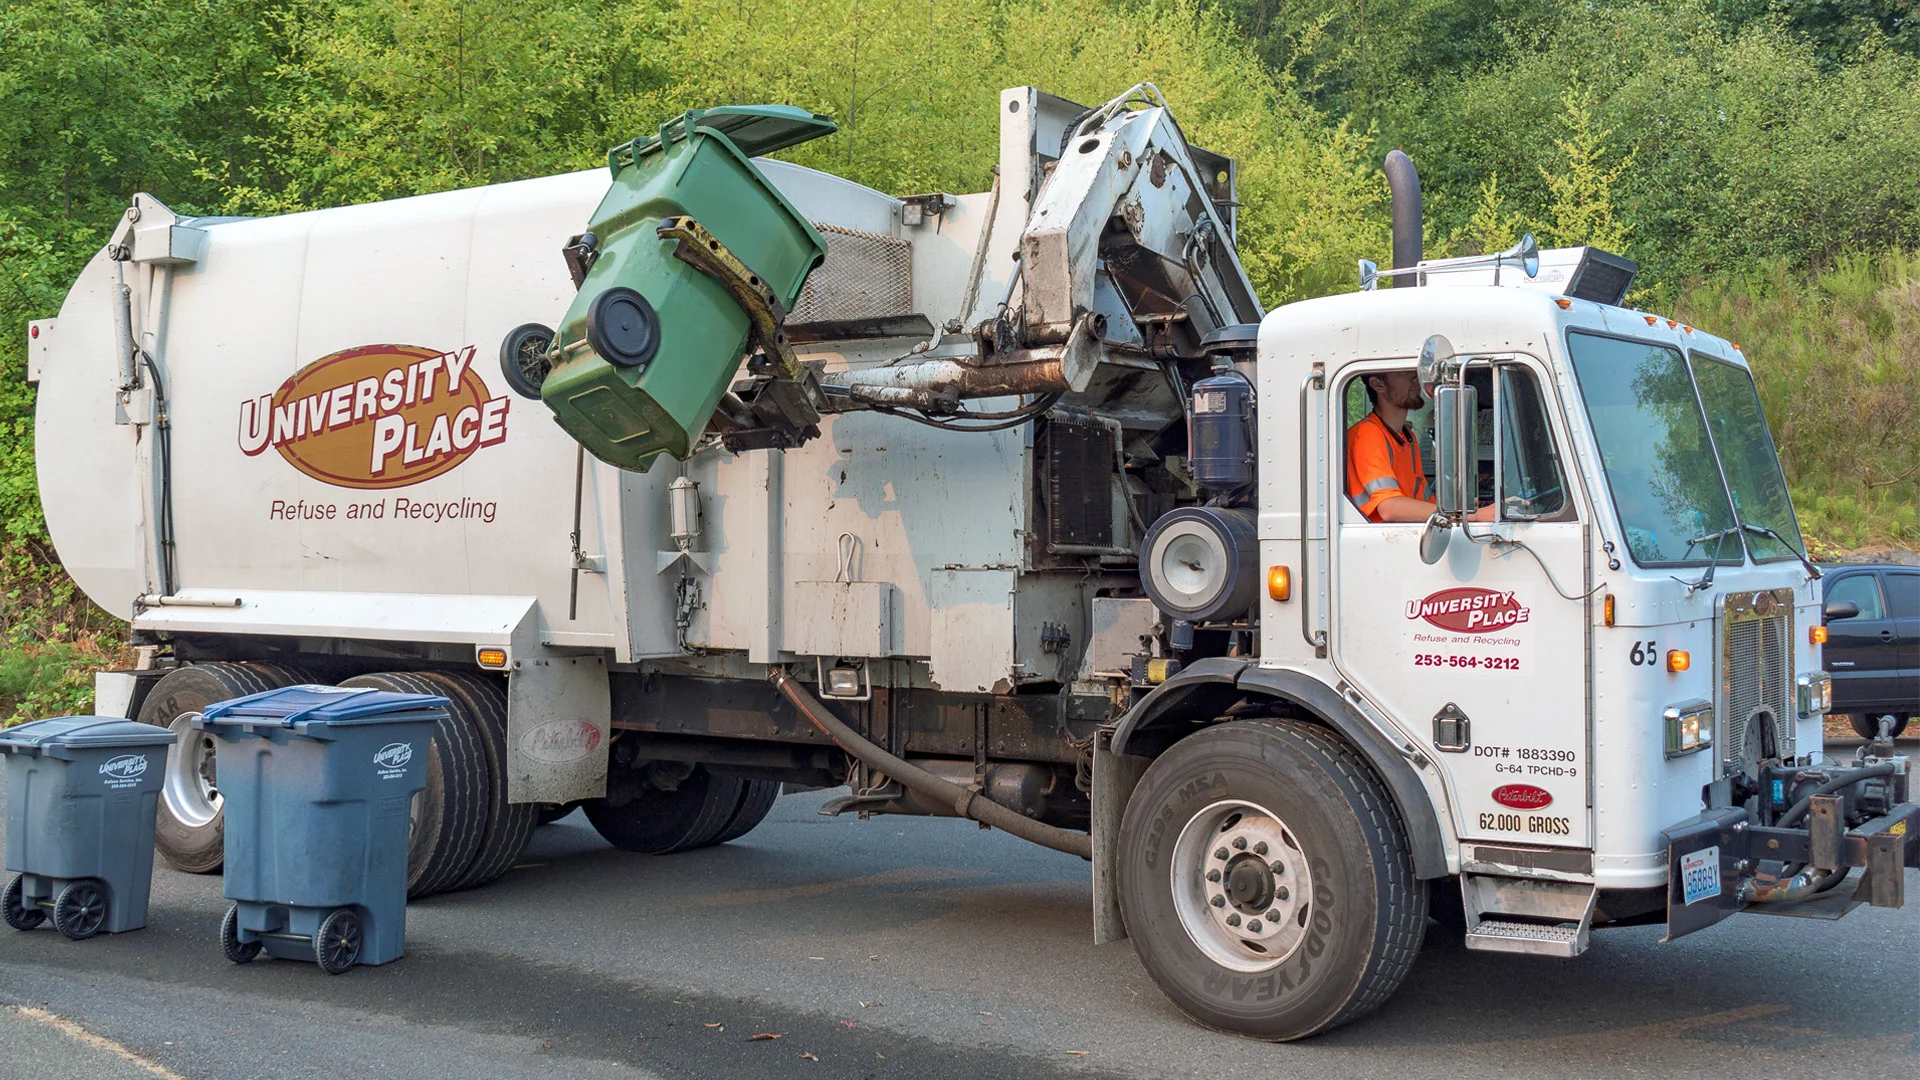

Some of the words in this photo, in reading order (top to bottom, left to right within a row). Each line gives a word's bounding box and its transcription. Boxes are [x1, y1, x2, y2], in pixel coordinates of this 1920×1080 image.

[238, 344, 476, 456] UNIVERSITY
[370, 395, 510, 478] PLACE
[269, 499, 337, 520] Refuse
[346, 498, 385, 519] and
[394, 497, 497, 523] Recycling
[1405, 591, 1515, 619] UNIVERSITY
[1467, 607, 1530, 629] PLACE
[1413, 633, 1447, 643] Refuse
[1451, 635, 1470, 644] and
[1473, 635, 1521, 647] Recycling
[1414, 653, 1520, 670] 253-564-3212
[1630, 640, 1657, 666] 65
[1474, 745, 1510, 758] DOT#
[1516, 748, 1575, 762] 1883390
[1495, 763, 1523, 774] G-64
[1527, 765, 1577, 777] TPCHD-9
[1498, 786, 1549, 804] Peterbilt
[1528, 815, 1570, 834] GROSS
[1203, 857, 1335, 1001] GOODYEAR
